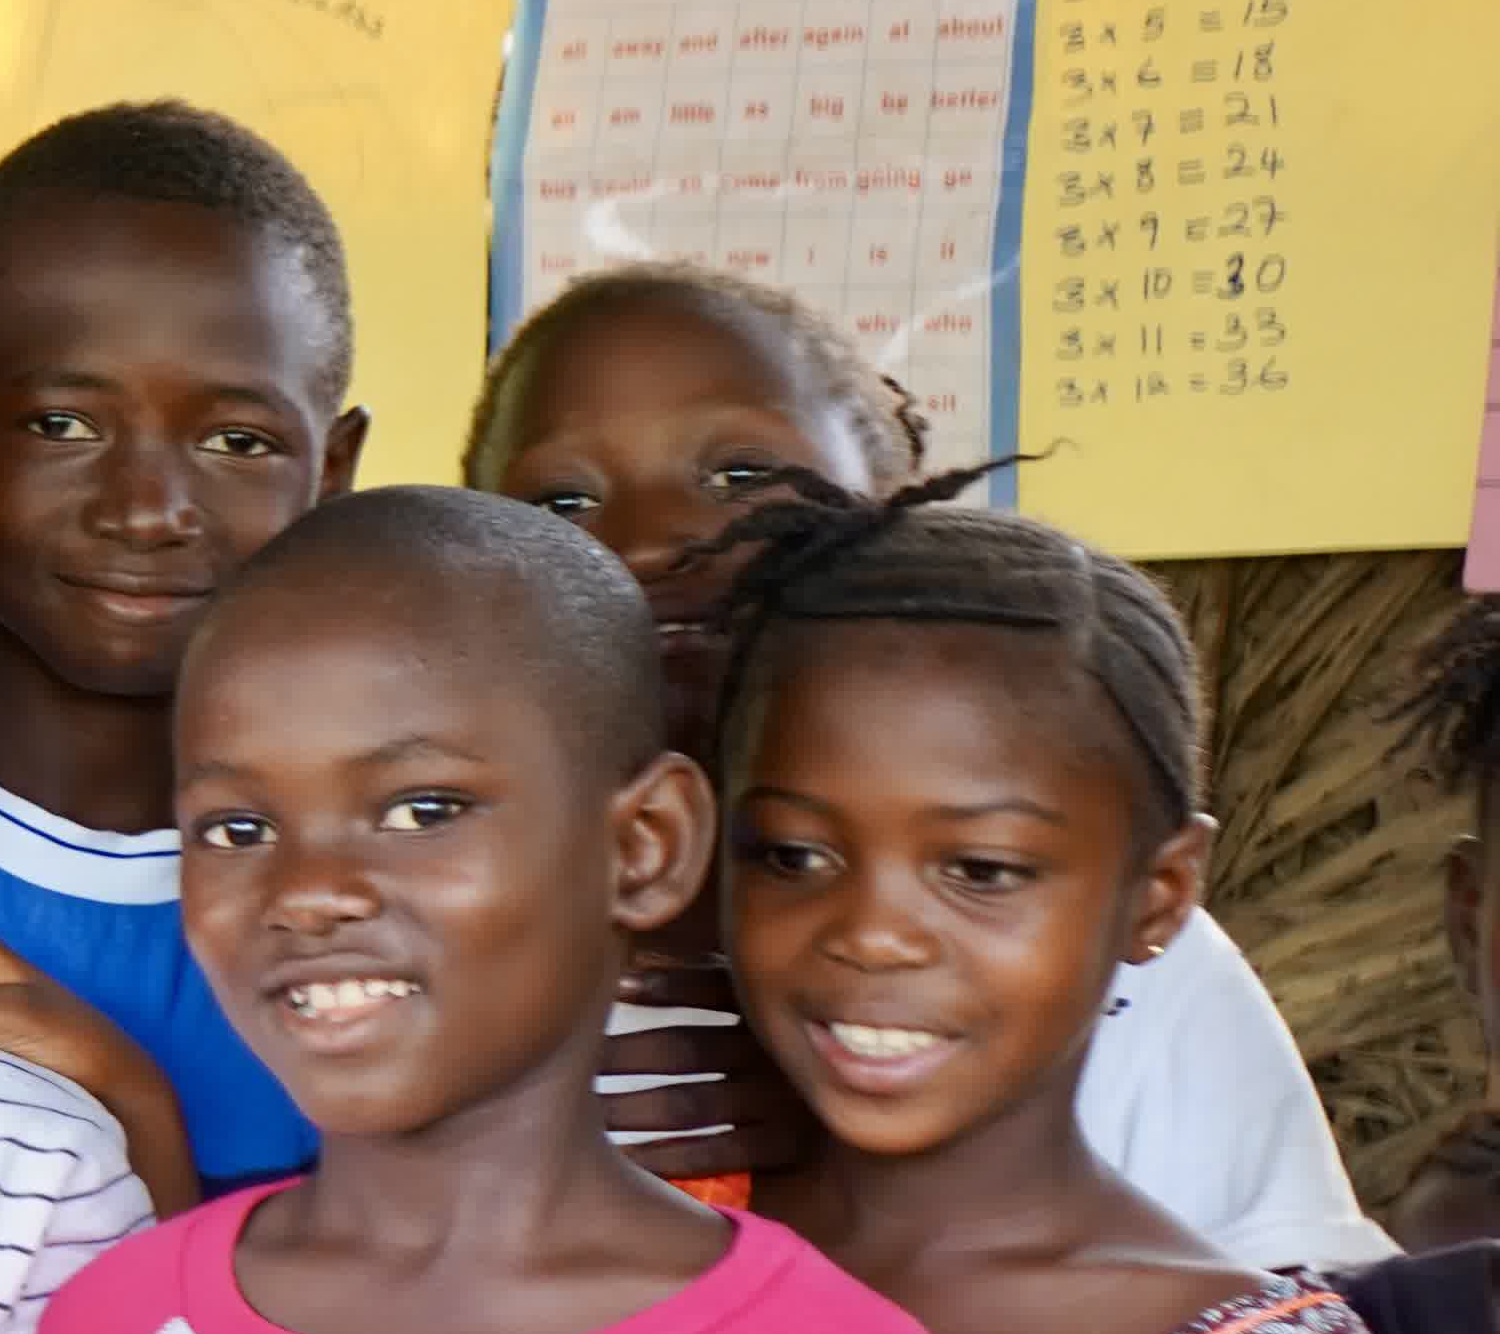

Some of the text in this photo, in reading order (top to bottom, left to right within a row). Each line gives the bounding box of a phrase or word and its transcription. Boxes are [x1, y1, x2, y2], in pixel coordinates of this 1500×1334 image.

[1060, 21, 1085, 54] 3
[1141, 8, 1164, 43] 5
[1062, 71, 1093, 106] 3
[1136, 57, 1162, 90] 6
[1233, 41, 1275, 81] 18
[1062, 117, 1092, 154] 3
[1132, 109, 1155, 147] 7
[1224, 92, 1280, 128] 21
[1057, 171, 1088, 209] 3
[1135, 156, 1155, 194] 8
[1223, 145, 1286, 181] 24
[1056, 224, 1088, 258] 3
[1140, 212, 1160, 252] 9
[1218, 195, 1286, 238] 27
[1052, 276, 1086, 315] 3
[1142, 267, 1173, 301] 10
[1215, 253, 1286, 301] 30
[1056, 327, 1085, 362] 3
[1140, 324, 1164, 356] 11
[1216, 307, 1286, 353] 33
[1055, 377, 1085, 408] 3
[1134, 375, 1171, 405] 12
[1218, 356, 1289, 396] 36
